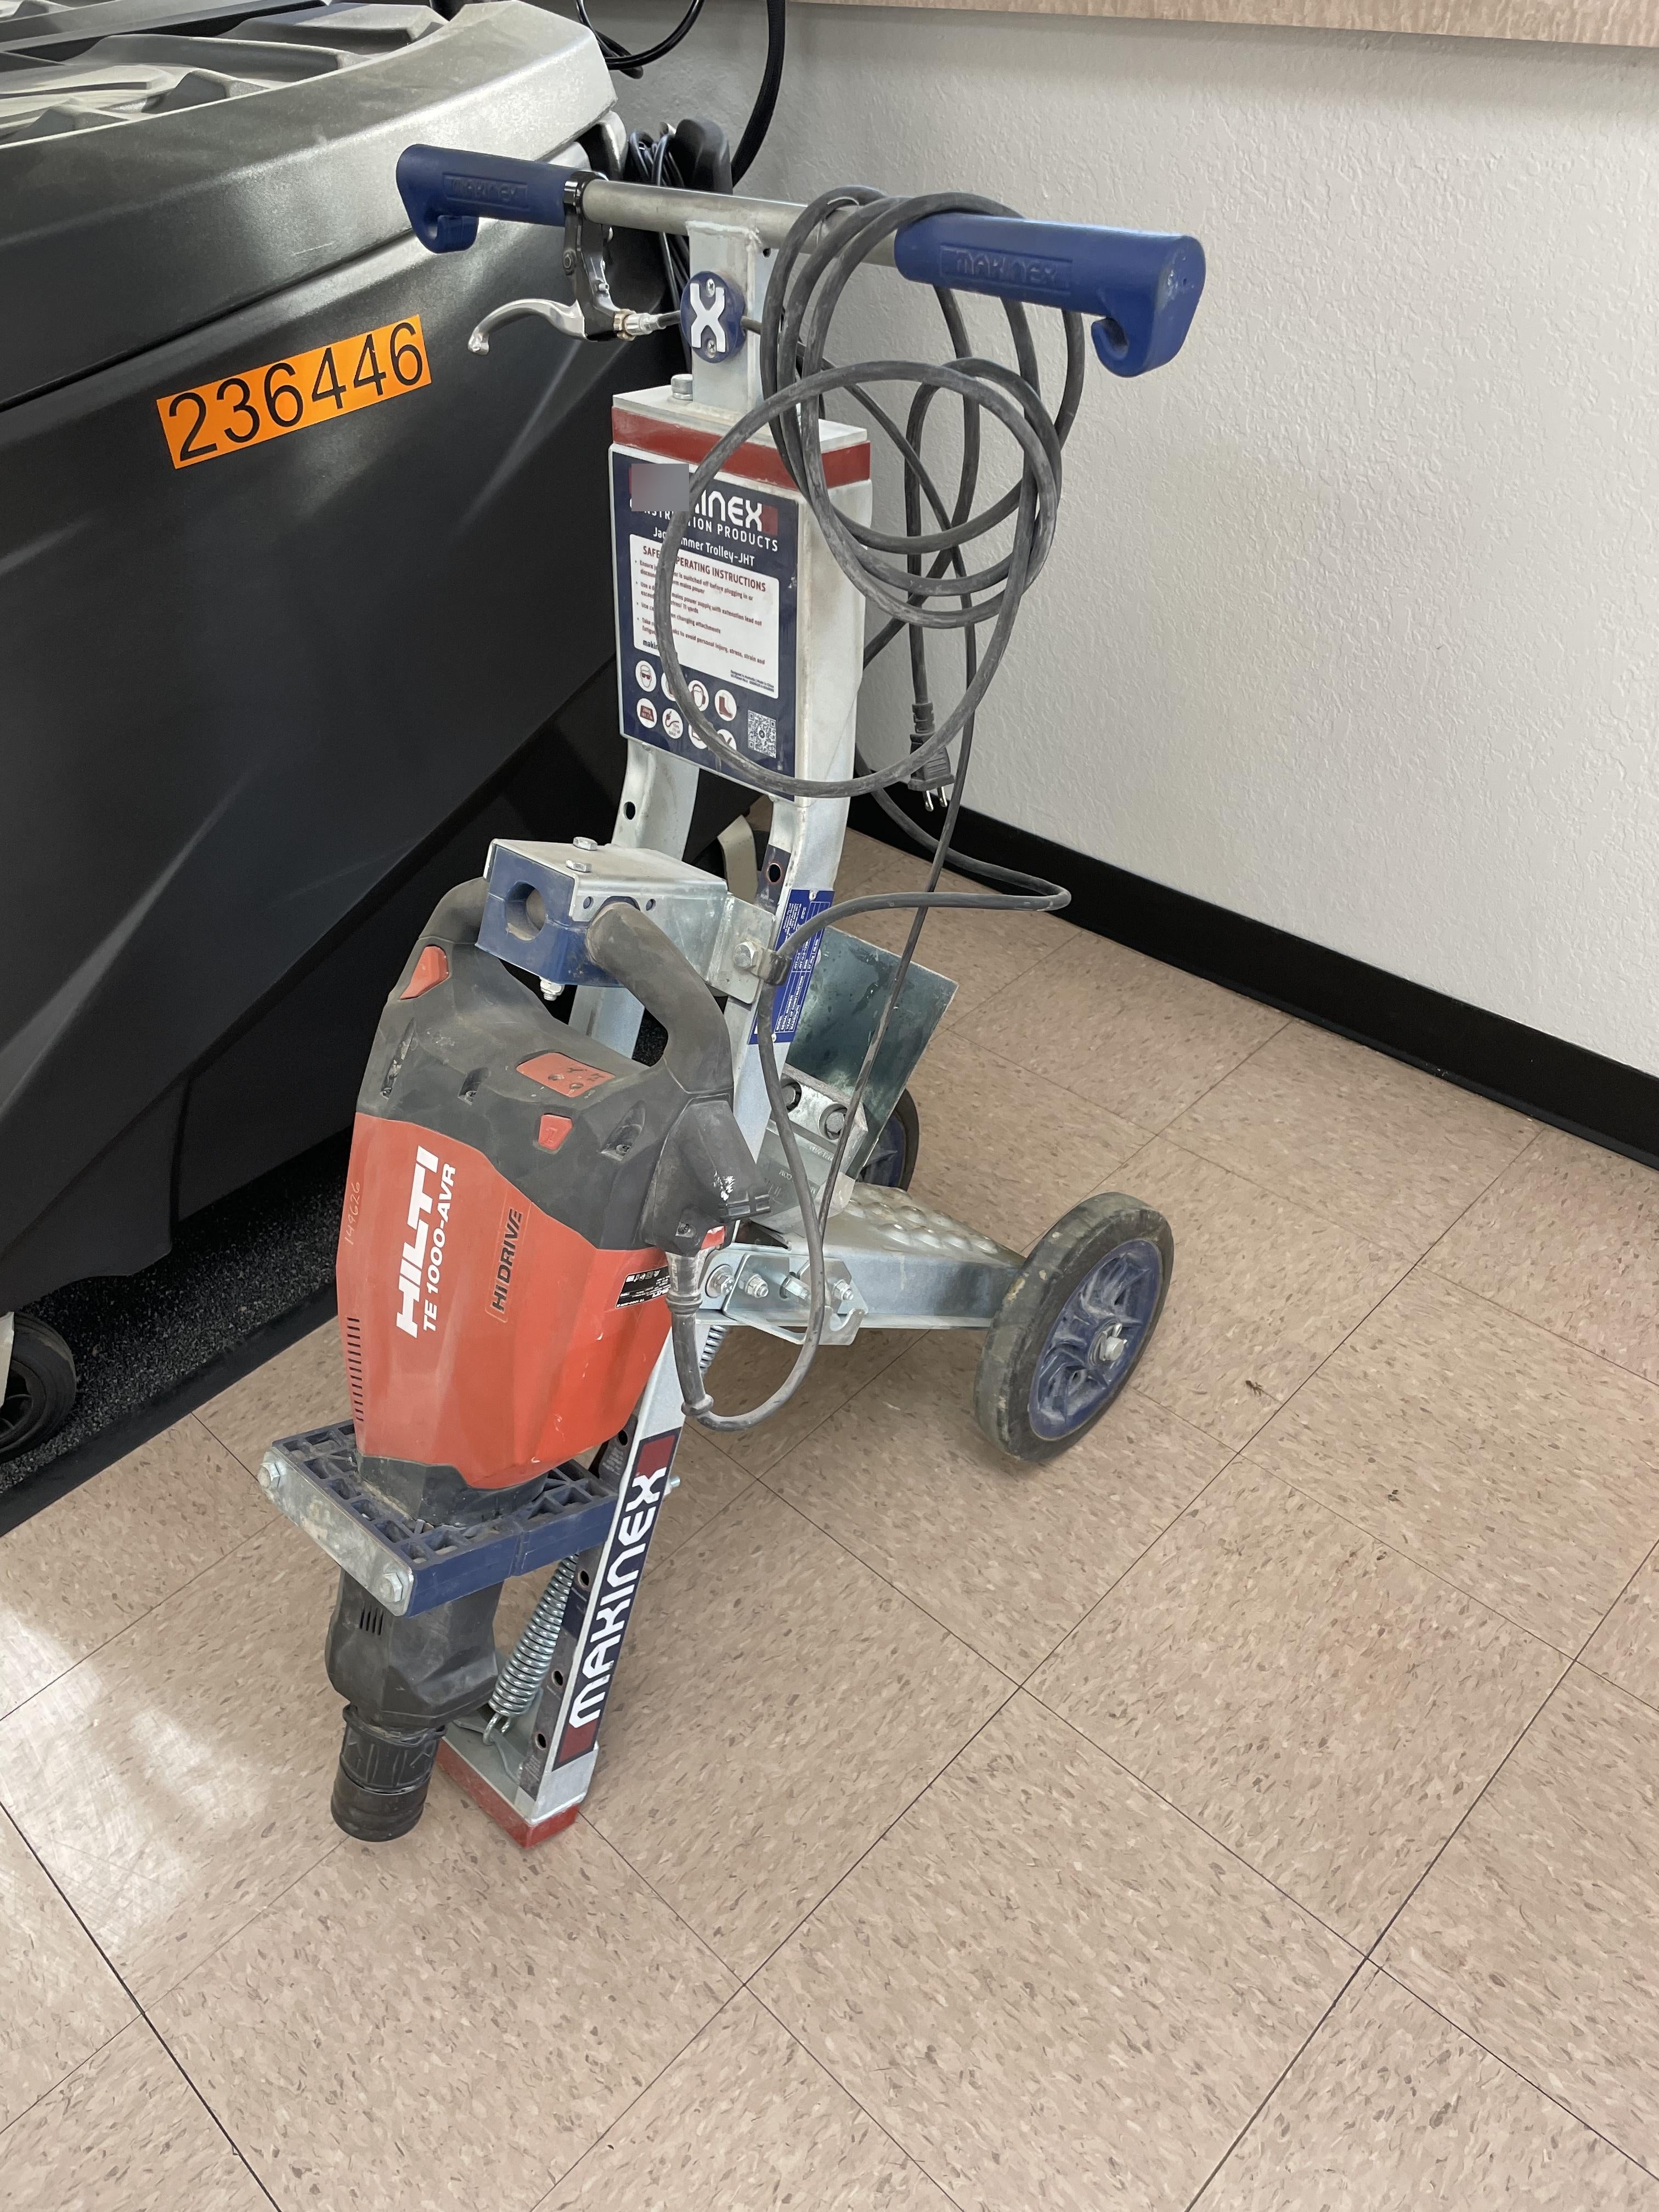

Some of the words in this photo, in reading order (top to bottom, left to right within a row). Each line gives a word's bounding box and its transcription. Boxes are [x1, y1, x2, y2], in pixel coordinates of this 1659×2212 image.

[169, 323, 424, 462] 236446
[643, 545, 660, 558] SAFE
[675, 556, 710, 574] PERATING
[712, 567, 766, 592] INSTRUCTIONS
[653, 526, 704, 551] Jacmmer
[706, 542, 755, 567] Trolley-JHT
[716, 522, 778, 552] PRODUCTS
[396, 1145, 439, 1339] HILTI
[428, 1163, 456, 1294] 1000-AVR
[424, 1299, 437, 1331] TE
[569, 1467, 666, 1728] MAKINEX
